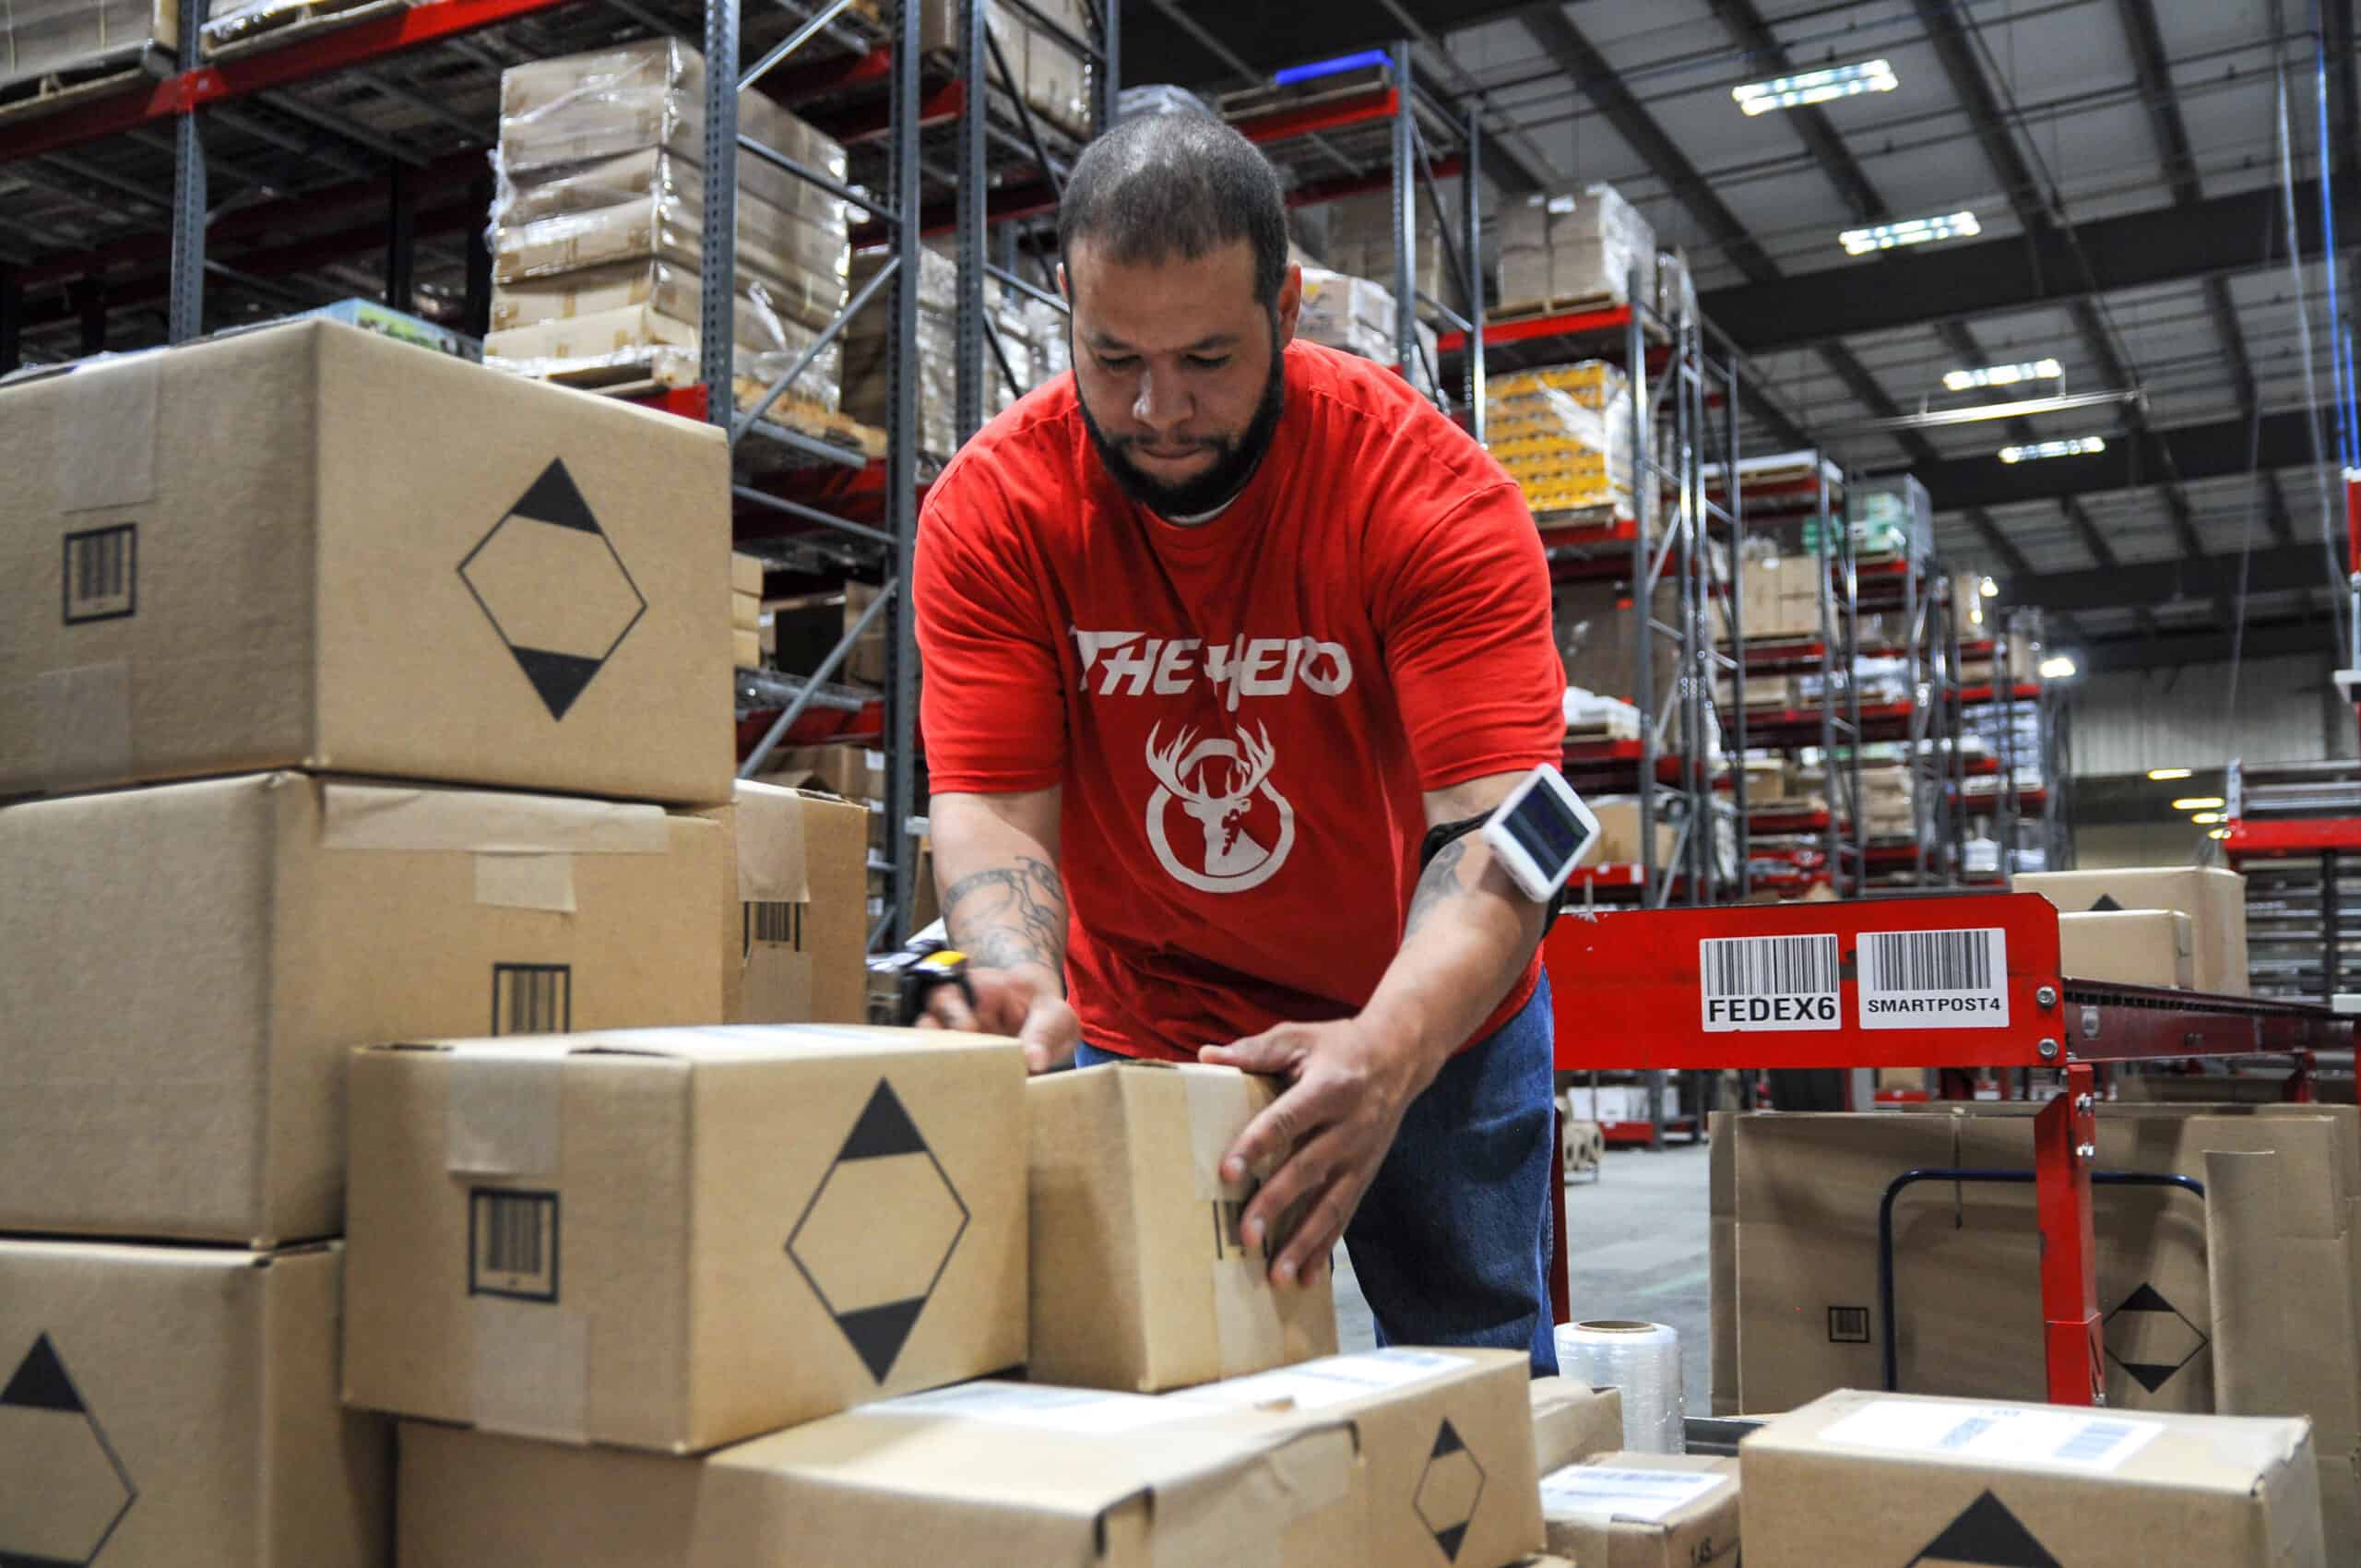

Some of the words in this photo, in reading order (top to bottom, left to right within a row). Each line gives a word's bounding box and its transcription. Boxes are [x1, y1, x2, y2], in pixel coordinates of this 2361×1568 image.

[1069, 626, 1202, 696] THE
[1708, 996, 1836, 1023] FEDEX6
[1868, 996, 2000, 1013] SMARTPOST4
